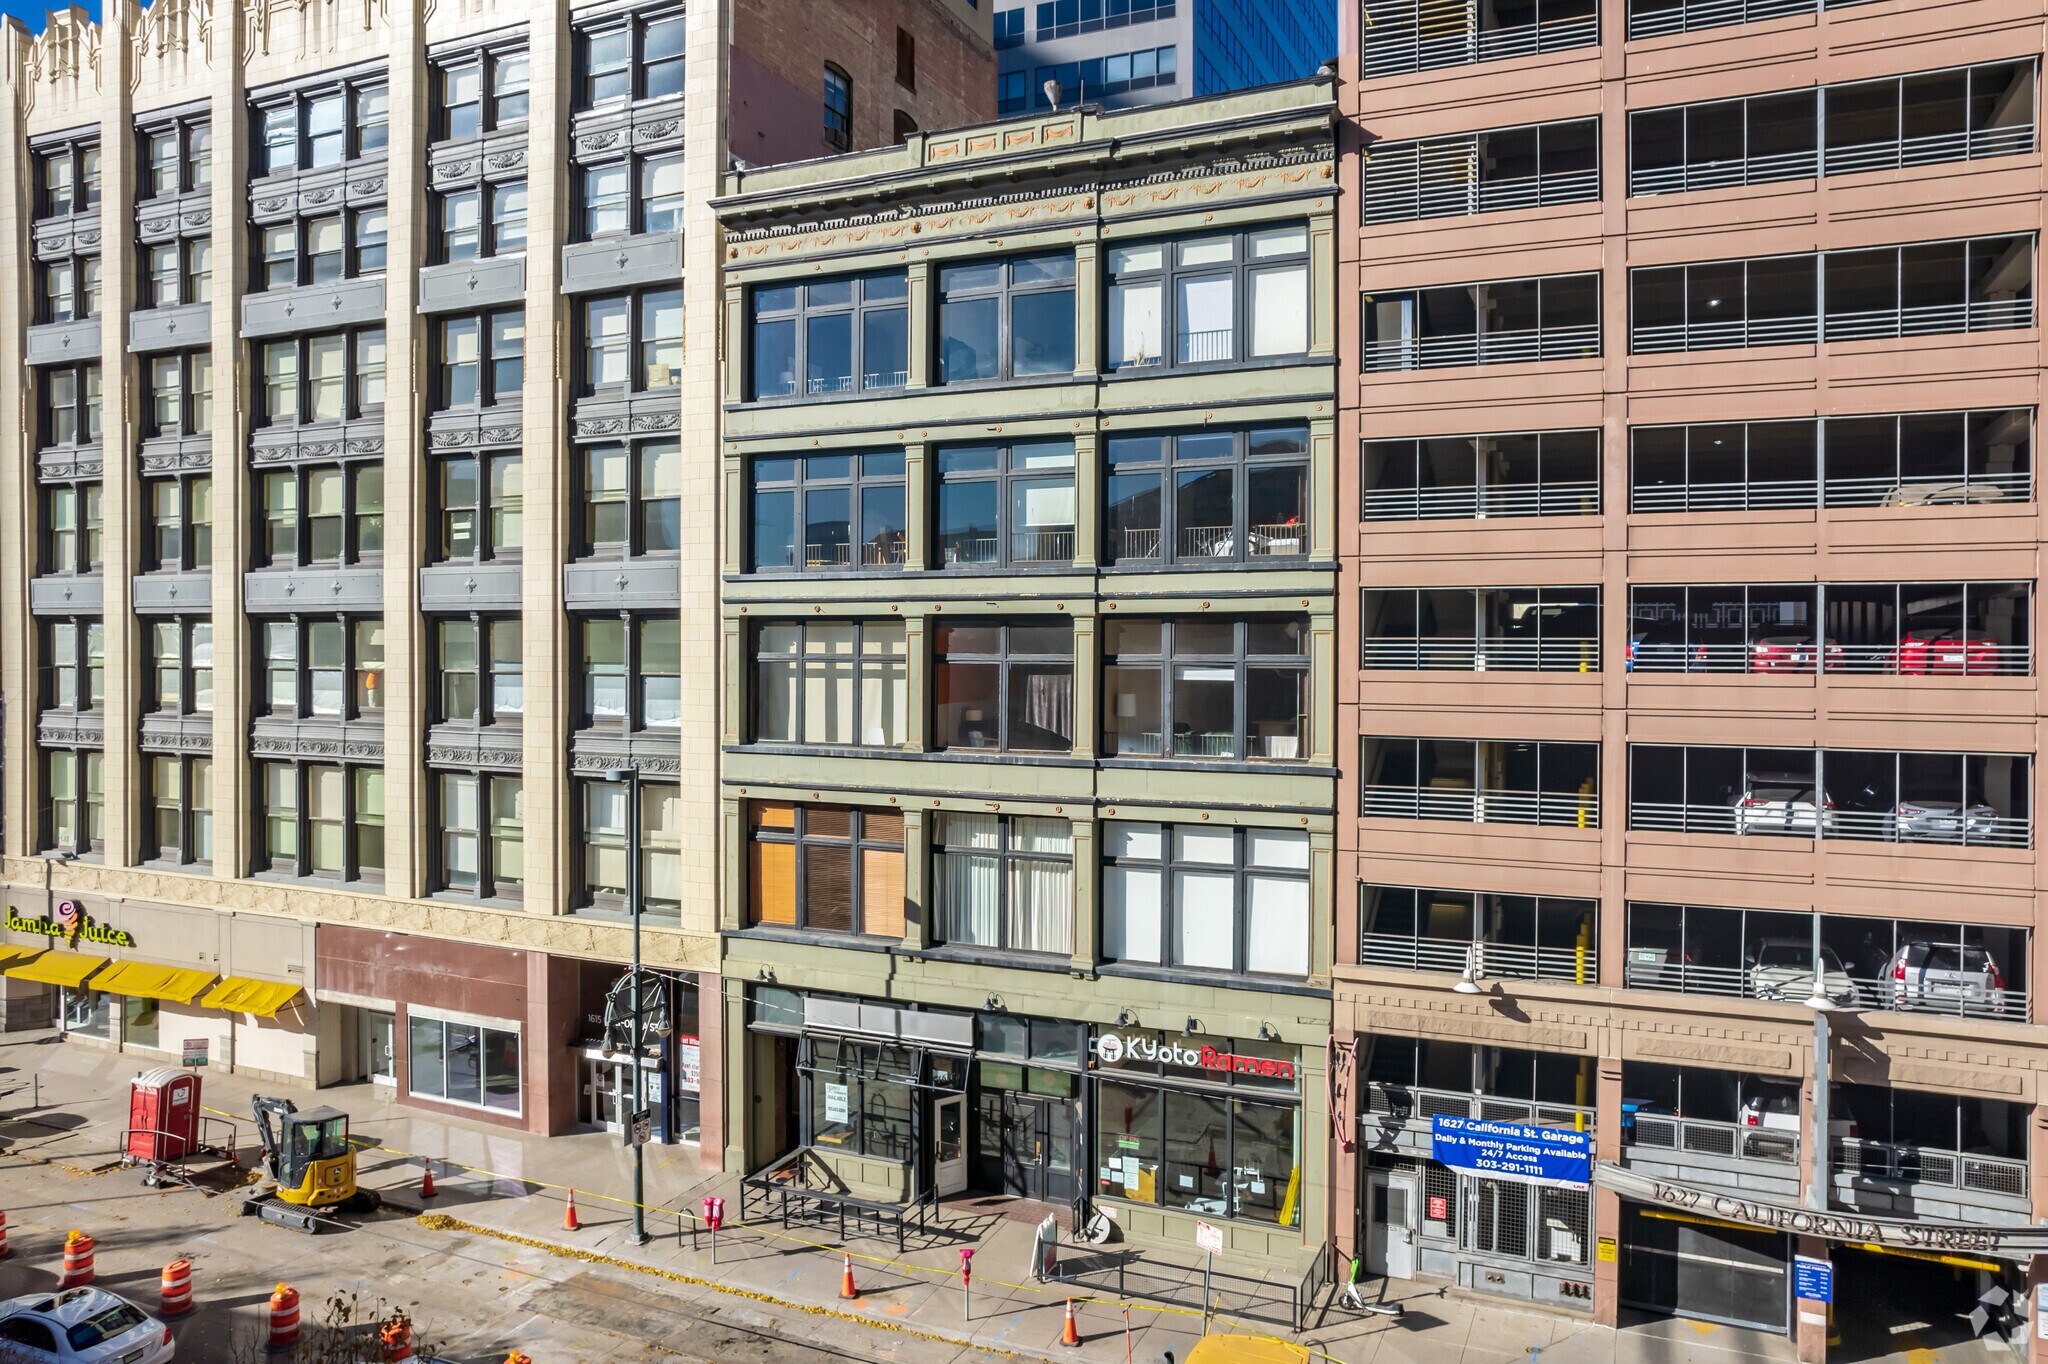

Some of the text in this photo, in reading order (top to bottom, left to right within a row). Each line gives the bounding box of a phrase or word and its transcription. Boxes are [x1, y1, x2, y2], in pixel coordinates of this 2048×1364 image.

[588, 1013, 602, 1024] 1615
[1126, 1035, 1293, 1079] Kyoto Ramen
[1438, 1117, 1584, 1144] 1627 California St. Garage
[1435, 1133, 1587, 1160] Daily & Monthly Parking Available
[1481, 1149, 1538, 1163] 24/7 Access
[1475, 1158, 1543, 1176] 303-291-1111
[1652, 1182, 2004, 1252] 1627 CALIFORNIA STREET
